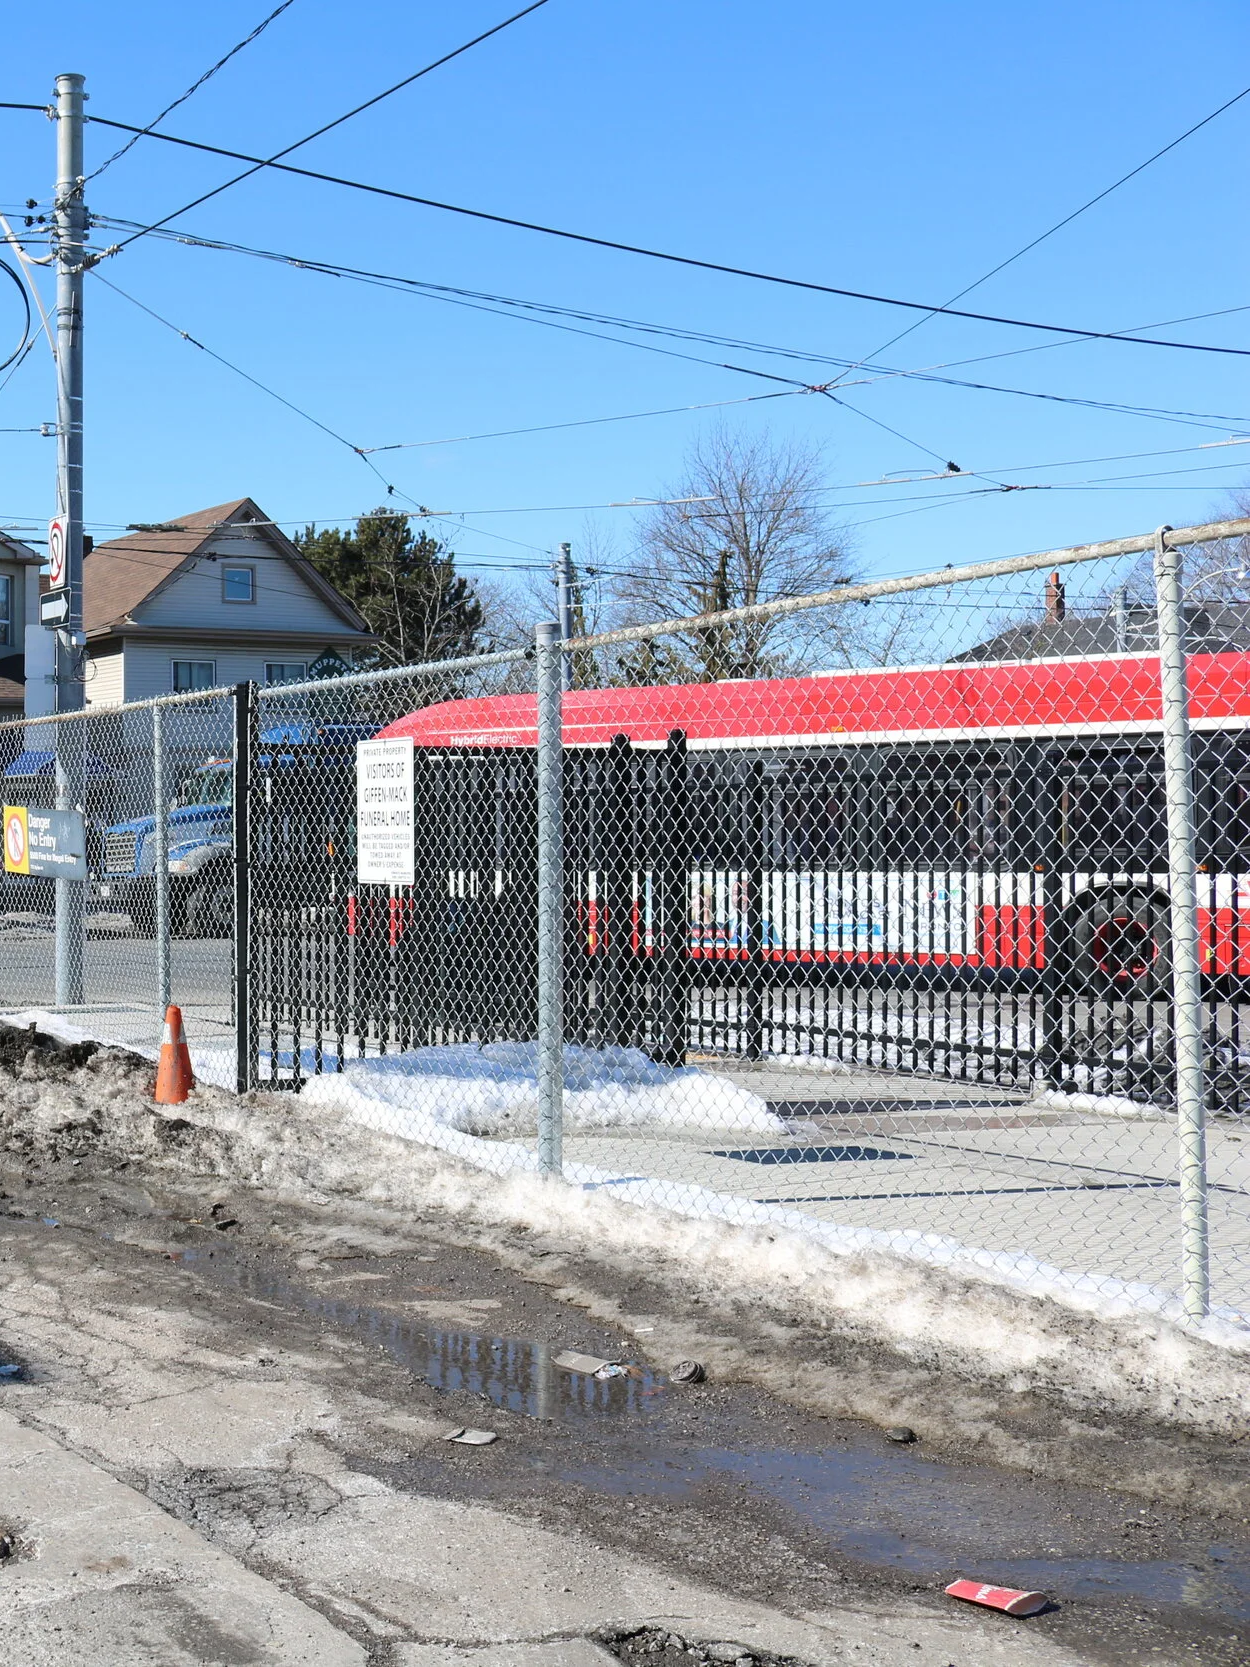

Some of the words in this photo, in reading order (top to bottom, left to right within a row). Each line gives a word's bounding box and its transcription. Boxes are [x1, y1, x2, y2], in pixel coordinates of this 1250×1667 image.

[363, 748, 382, 757] PRIVATE
[383, 746, 407, 756] PROPERTY
[366, 762, 395, 779] VISITORS
[395, 761, 405, 778] OF
[364, 785, 408, 803] GIFFEN-MACK
[28, 813, 51, 832] Danger
[361, 810, 389, 826] FUNERAL
[390, 810, 410, 826] HOME
[28, 831, 38, 846] No
[39, 832, 57, 851] Entry
[361, 833, 390, 841] UNAUTHORIZED
[378, 842, 394, 850] TAGGED
[370, 851, 384, 859] TOWED
[384, 851, 396, 859] AWAY
[396, 851, 402, 859] AT
